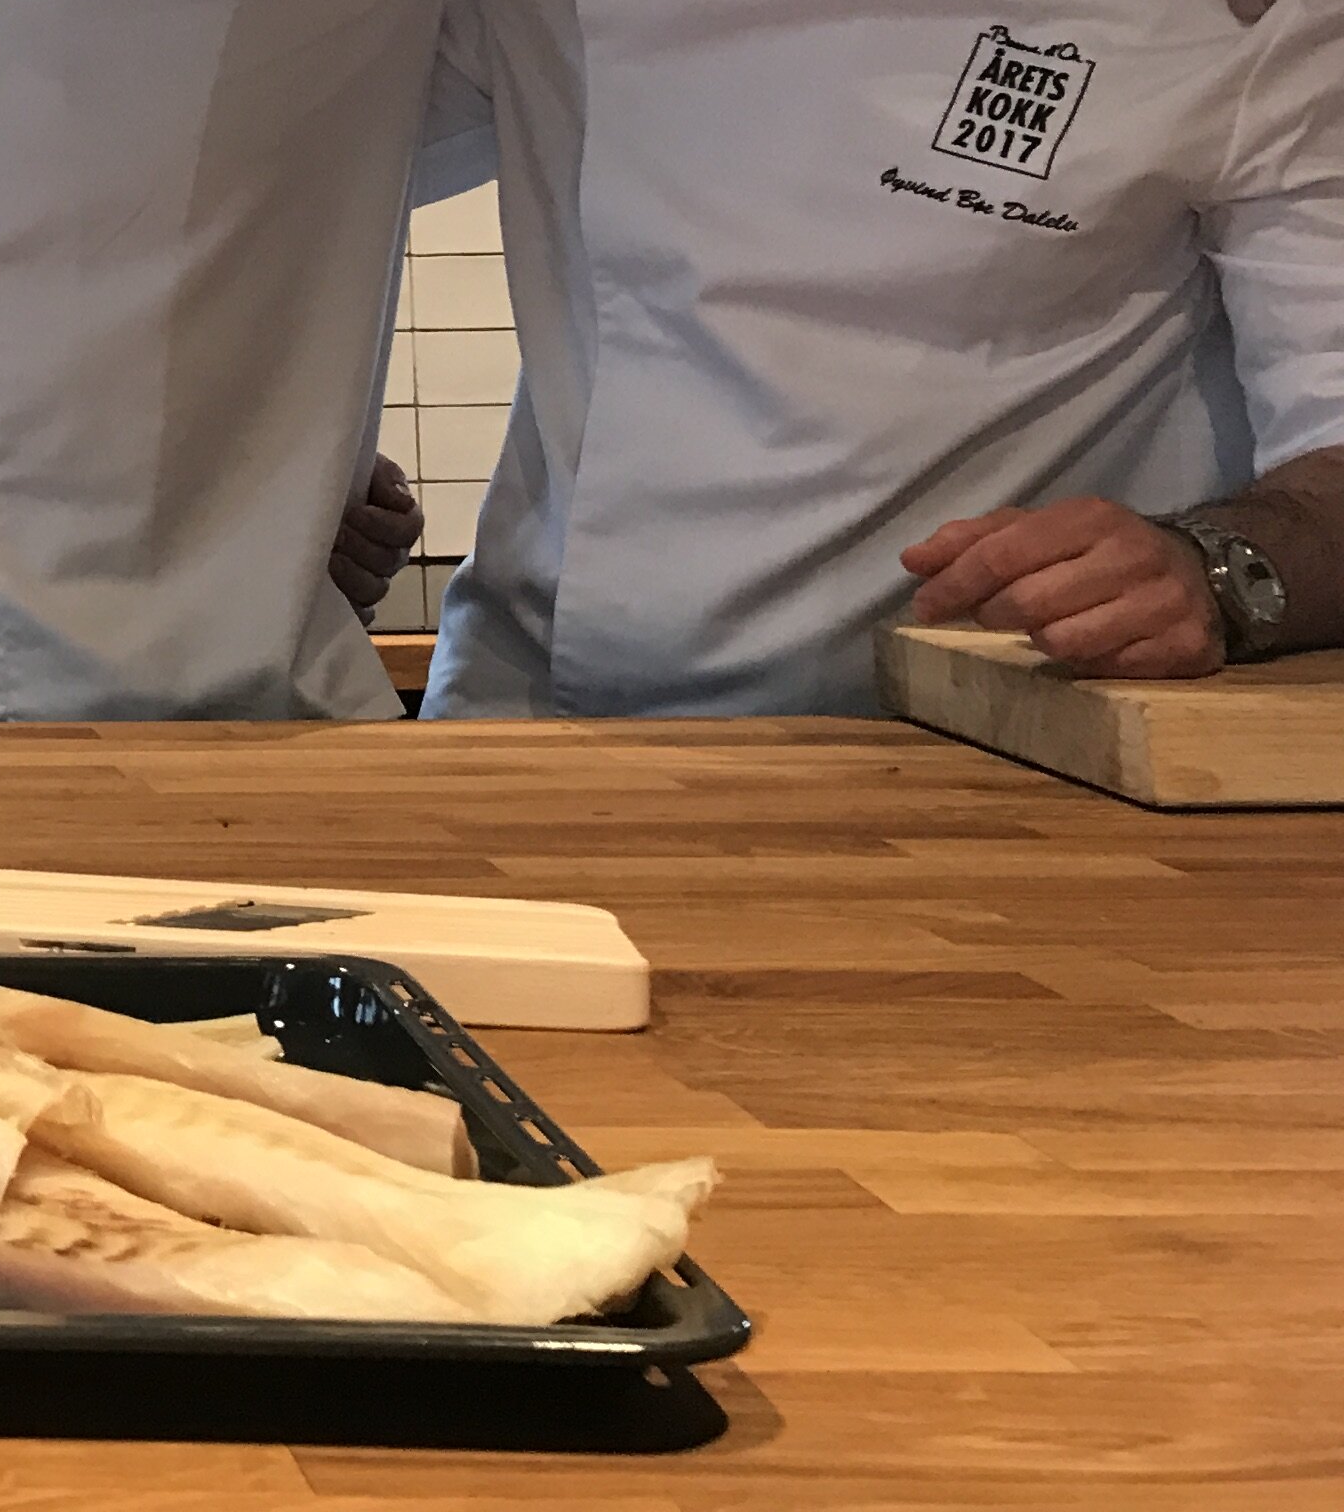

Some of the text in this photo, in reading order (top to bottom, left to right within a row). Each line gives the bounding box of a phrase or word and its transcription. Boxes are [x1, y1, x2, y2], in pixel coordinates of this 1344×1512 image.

[976, 48, 1069, 101] ÅRETS
[965, 86, 1056, 133] KOKK
[951, 119, 1043, 163] 2017
